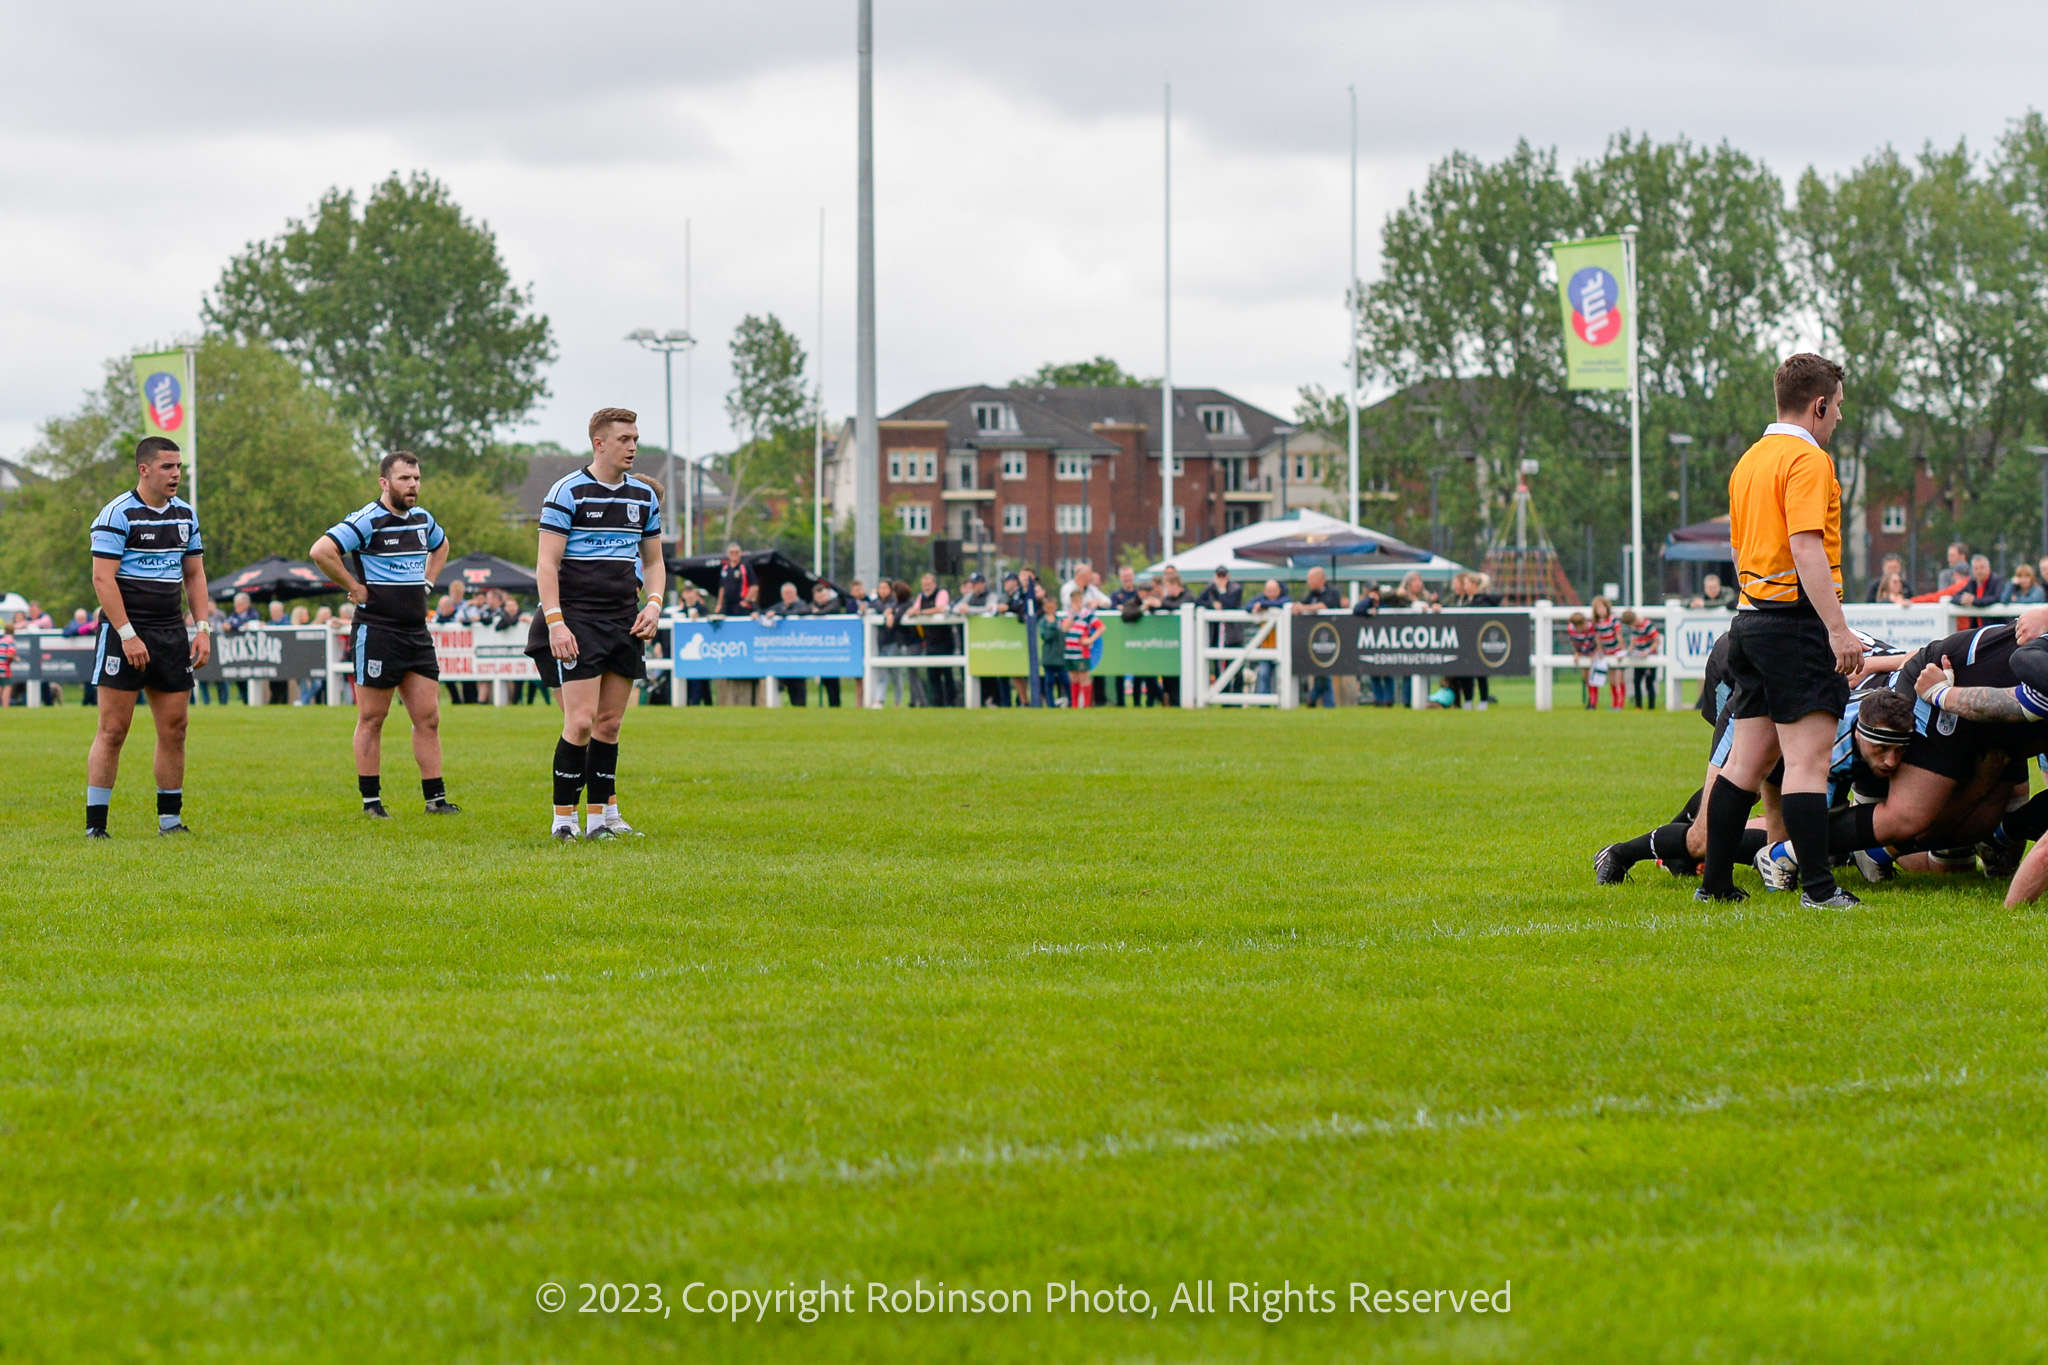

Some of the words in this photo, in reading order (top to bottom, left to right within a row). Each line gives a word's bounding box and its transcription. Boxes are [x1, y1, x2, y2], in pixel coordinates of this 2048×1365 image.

[753, 631, 851, 650] aspensolutions.co.uk
[1357, 625, 1460, 650] MALCOLM
[701, 640, 748, 664] aspen
[1374, 653, 1443, 665] CONSTRUCTION
